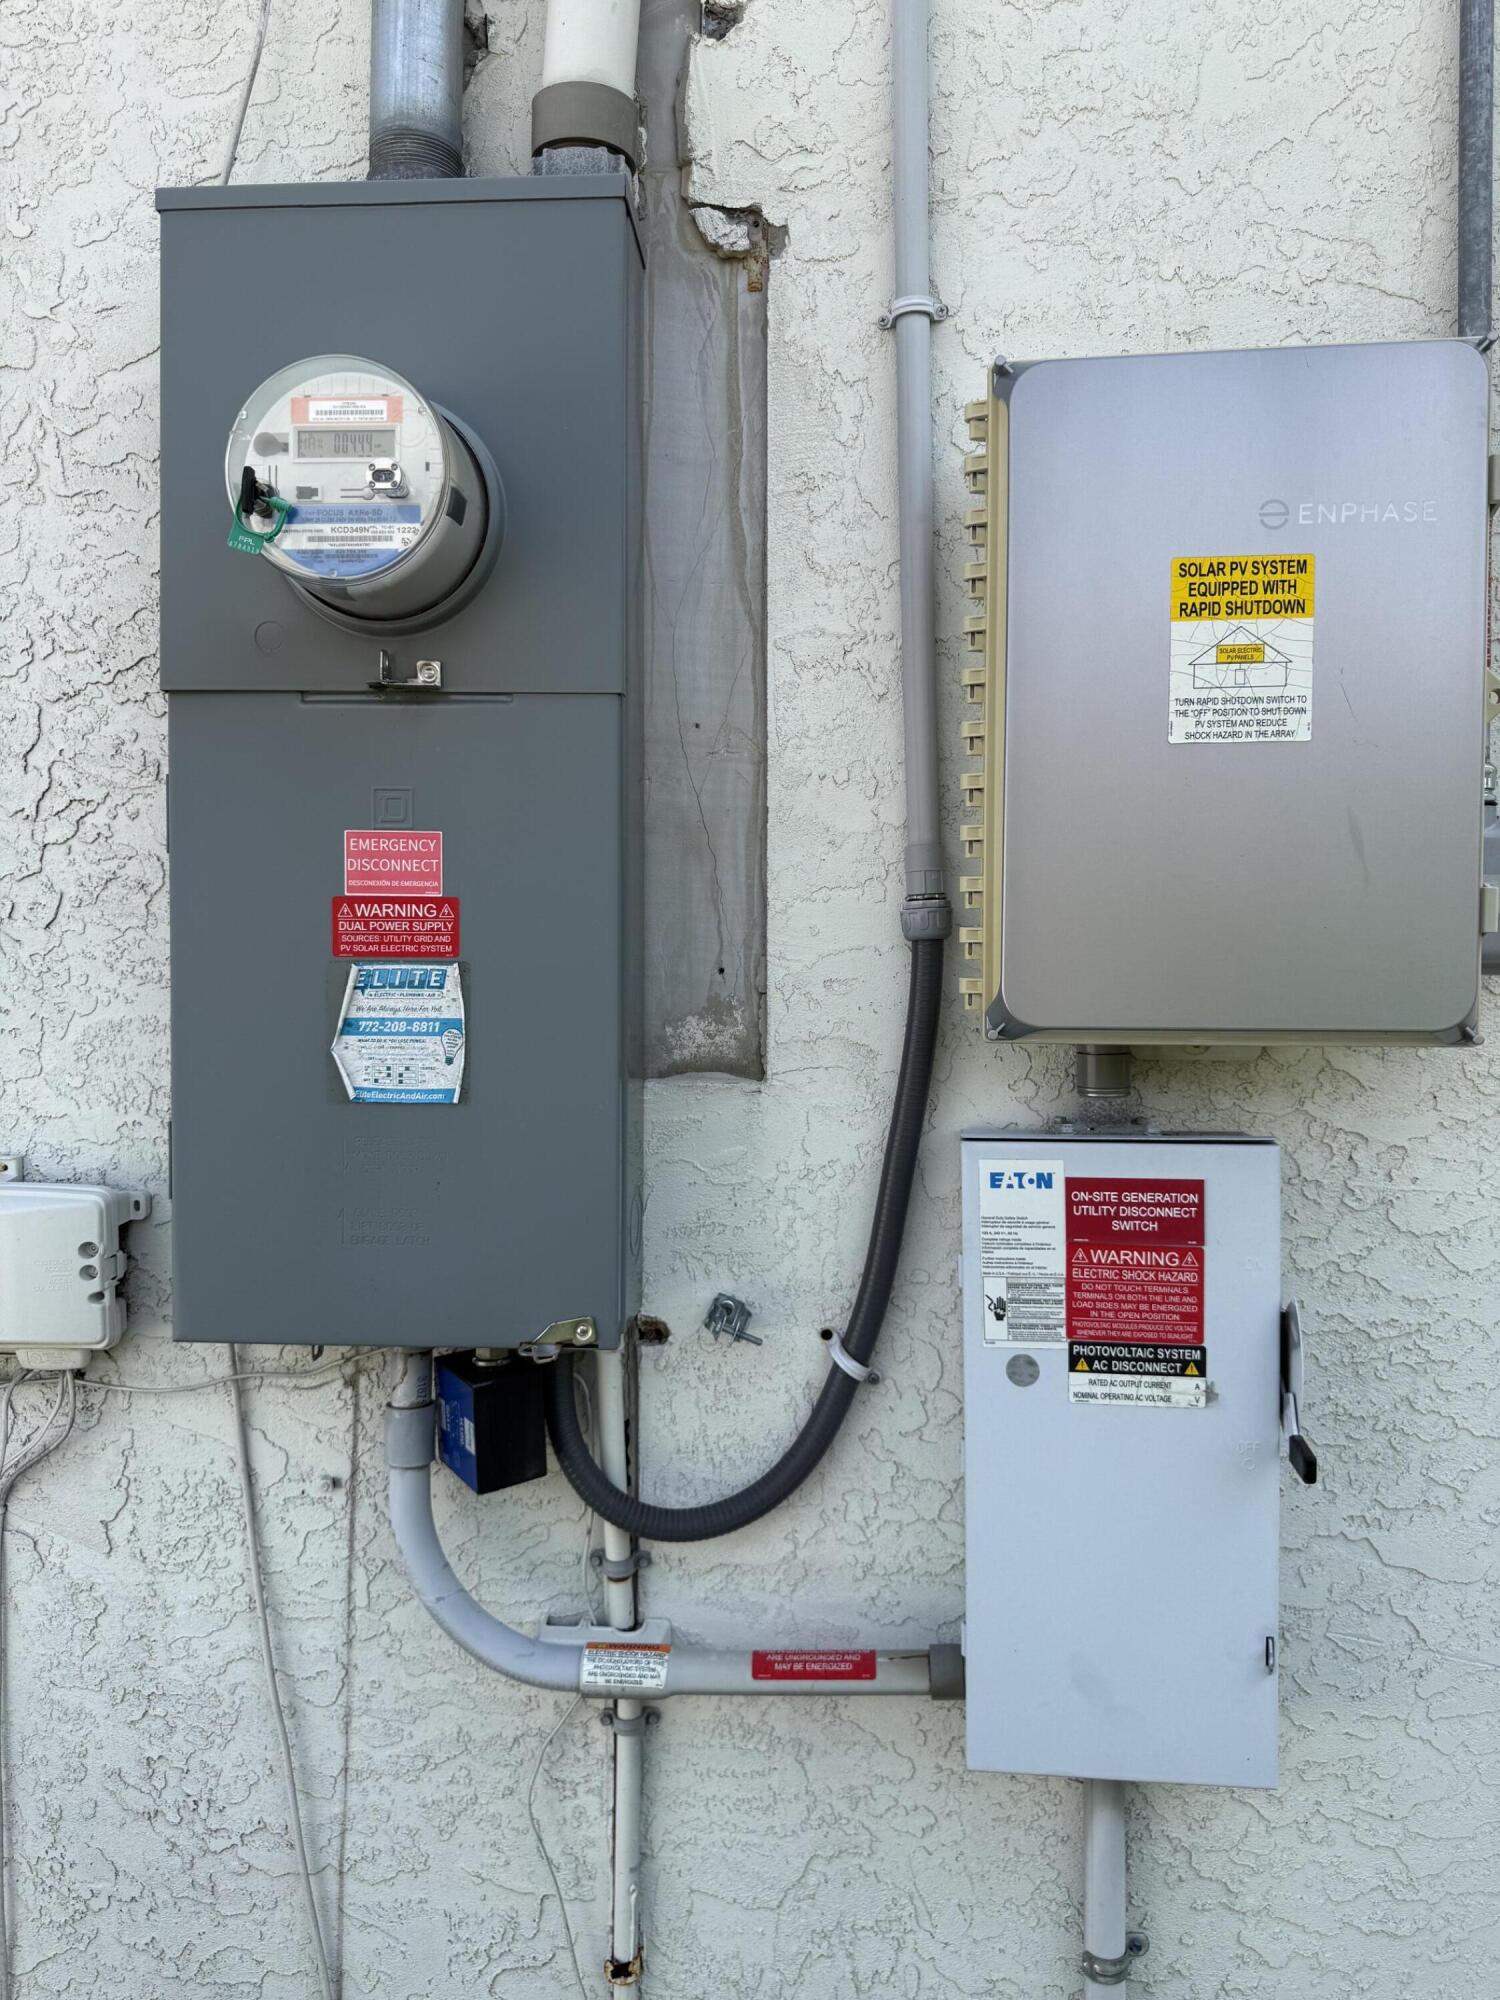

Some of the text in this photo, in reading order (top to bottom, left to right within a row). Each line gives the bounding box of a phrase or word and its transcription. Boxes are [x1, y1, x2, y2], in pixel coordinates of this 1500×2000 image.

[1298, 500, 1437, 524] ENPHASE
[330, 526, 370, 534] KCD349N
[1179, 559, 1307, 578] SOLAR PV SYSTEM
[1188, 579, 1297, 597] EQUIPPED WITH
[1180, 599, 1306, 617] RAPID SHUTDOWN
[1175, 695, 1307, 706] TURN RAPID SHUTDOWN SWITCH TO
[1174, 707, 1306, 717] THE "OFF" POSITION TO SHUT DOWN
[1195, 718, 1287, 728] PV SYSTEM AND REDUCE
[1184, 729, 1296, 740] SHOCK HAZARD IN THE ARRAY
[350, 838, 437, 852] EMERGENCY
[347, 858, 439, 872] DISCONNECT
[348, 879, 391, 887] DESCONEXIÓN
[354, 903, 437, 918] WARNING
[338, 921, 454, 931] DUAL POWER SUPPLY
[356, 970, 443, 987] ELITE
[1071, 1191, 1199, 1204] ON-SITE GENERATION
[1073, 1205, 1197, 1218] UTILITY DISCONNECT
[1111, 1220, 1158, 1231] SWITCH
[1090, 1249, 1180, 1266] WARNING
[1072, 1268, 1119, 1279] ELECTRIC
[1121, 1270, 1156, 1281] SHOCK
[1158, 1271, 1198, 1282] HAZARD
[1095, 1283, 1112, 1291] NOT
[1114, 1284, 1142, 1292] TOUCH
[1144, 1285, 1189, 1293] TERMINALS
[1073, 1292, 1113, 1300] TERMINALS
[1148, 1294, 1163, 1302] THE
[1120, 1302, 1137, 1310] MAY
[1139, 1303, 1149, 1311] BE
[1151, 1304, 1197, 1312] ENERGIZED
[1117, 1311, 1140, 1319] OPEN
[1142, 1312, 1180, 1320] POSITION
[1072, 1344, 1201, 1360] PHOTOVOLTAIC SYSTEM
[1092, 1360, 1182, 1373] AC DISCONNECT
[1088, 1378, 1108, 1387] RATED
[1118, 1380, 1143, 1388] OUTPUT
[1143, 1381, 1172, 1390] CURRENT
[1194, 1383, 1200, 1391] A
[1072, 1392, 1200, 1404] NOMINAL OPERATING AC VOLTAGE V
[774, 1662, 853, 1670] MAY BE ENERGIZED
